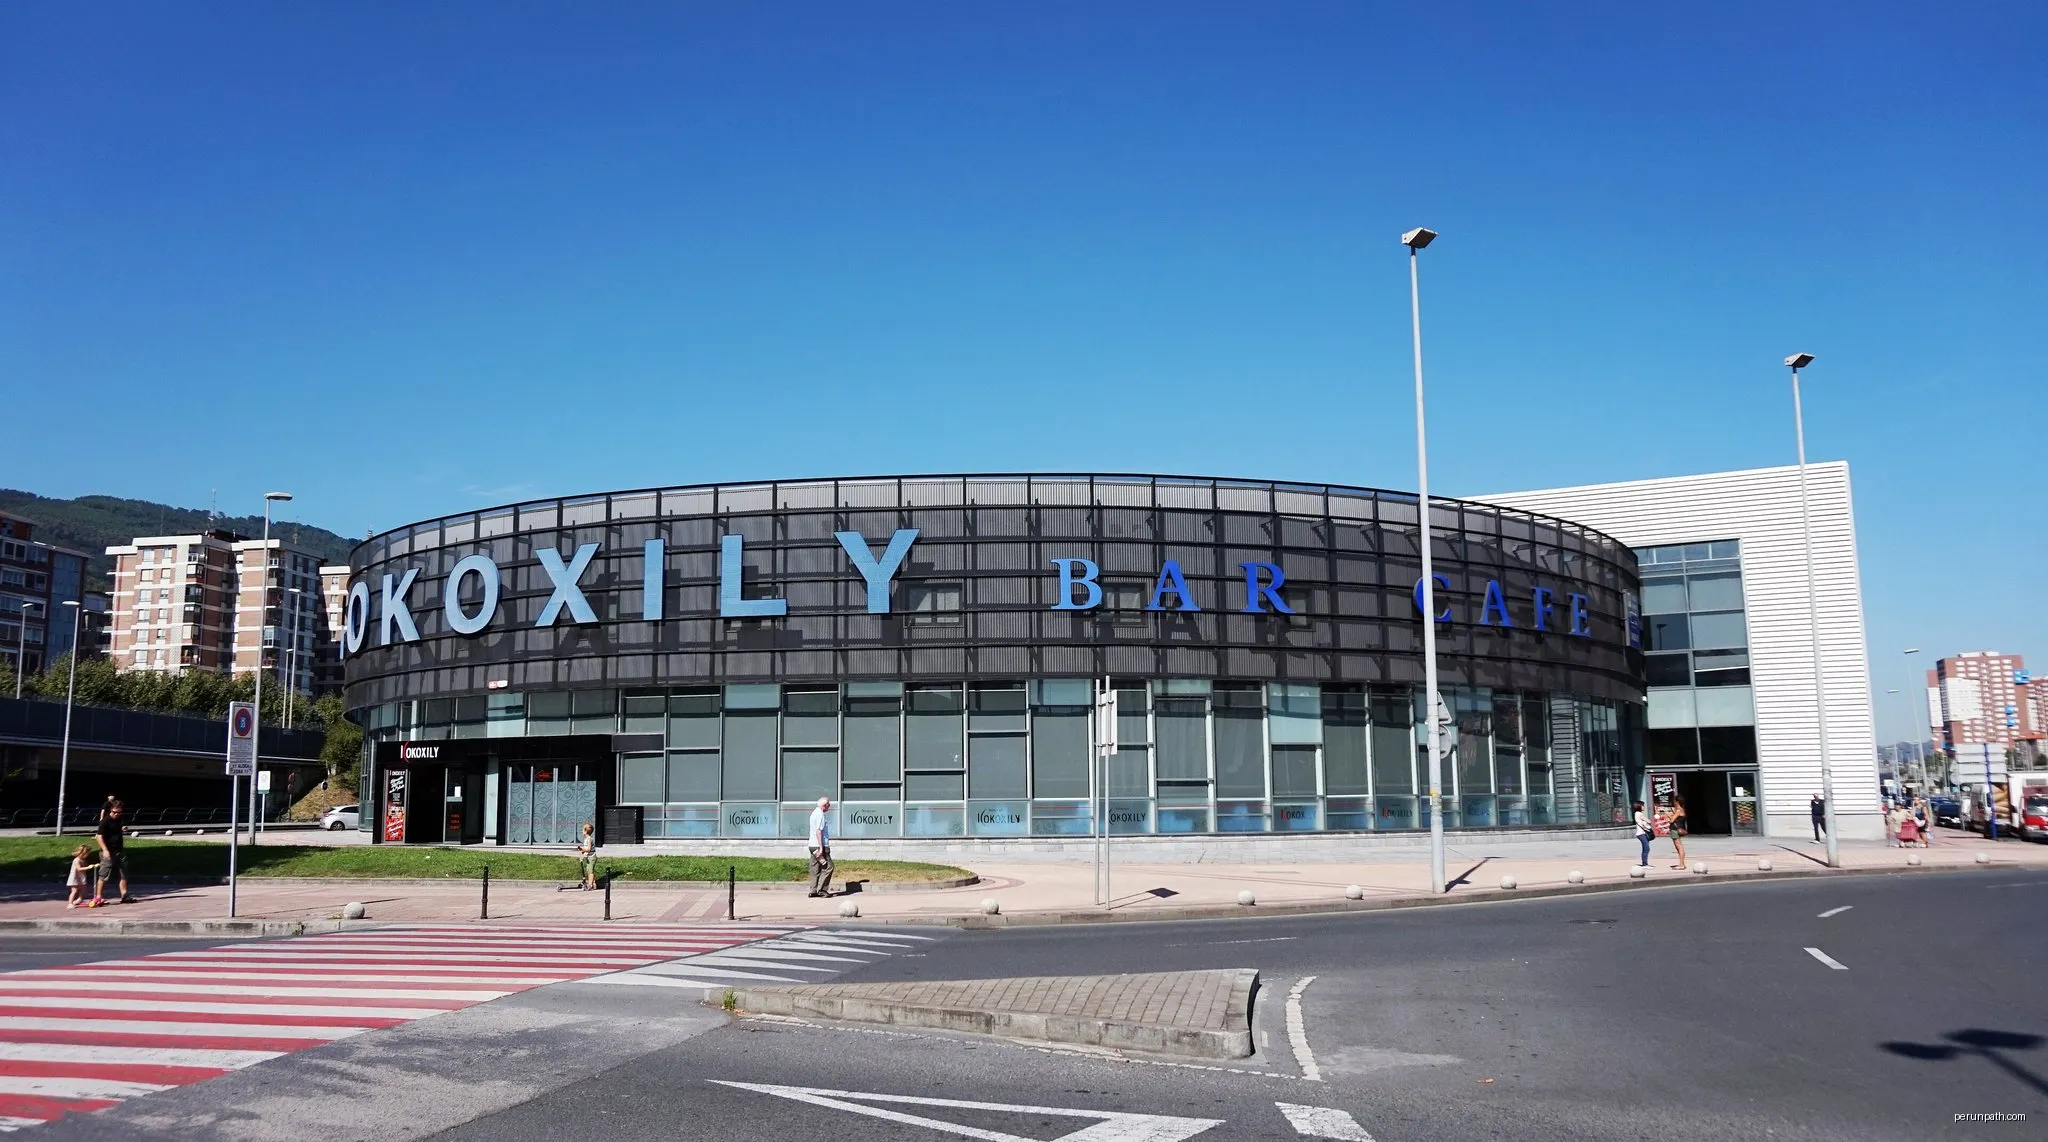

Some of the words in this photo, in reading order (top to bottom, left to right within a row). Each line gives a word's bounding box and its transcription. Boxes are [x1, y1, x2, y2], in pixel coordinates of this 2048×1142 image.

[340, 528, 921, 659] OKOXILY
[1050, 558, 1297, 614] BAR
[1412, 573, 1592, 637] CAFE
[400, 742, 439, 761] KOKOXILY
